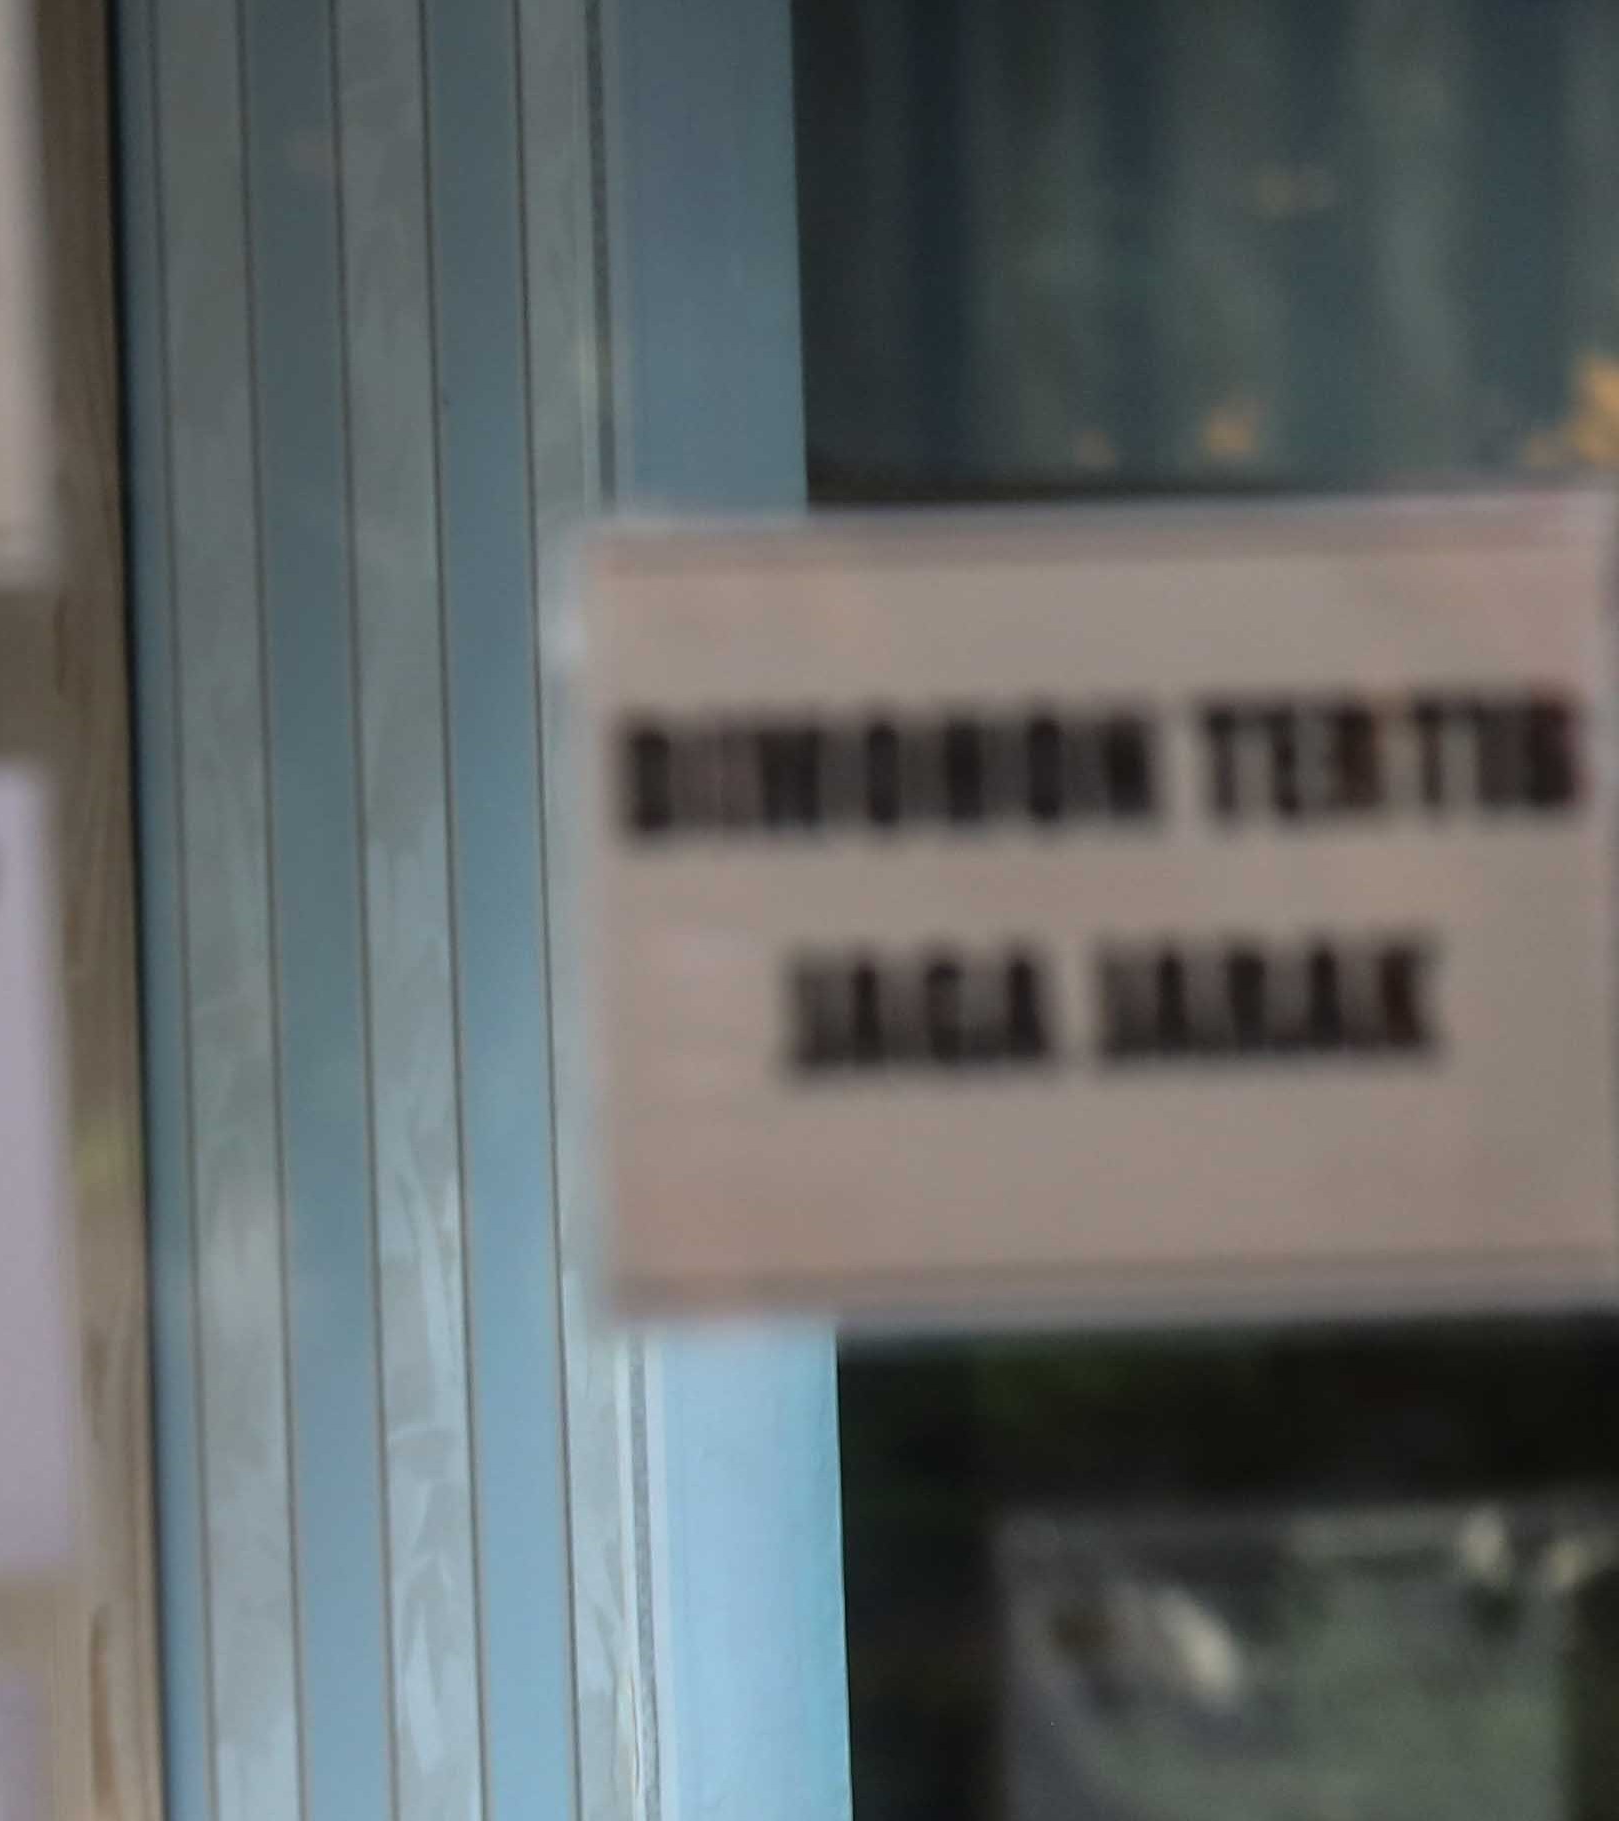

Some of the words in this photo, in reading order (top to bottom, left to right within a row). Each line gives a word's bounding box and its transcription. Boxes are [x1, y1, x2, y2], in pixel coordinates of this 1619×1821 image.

[617, 710, 1159, 842] DIMOHON
[1203, 687, 1581, 822] TERTIB
[783, 942, 1053, 1080] JAGA
[1093, 928, 1441, 1070] JARAK
